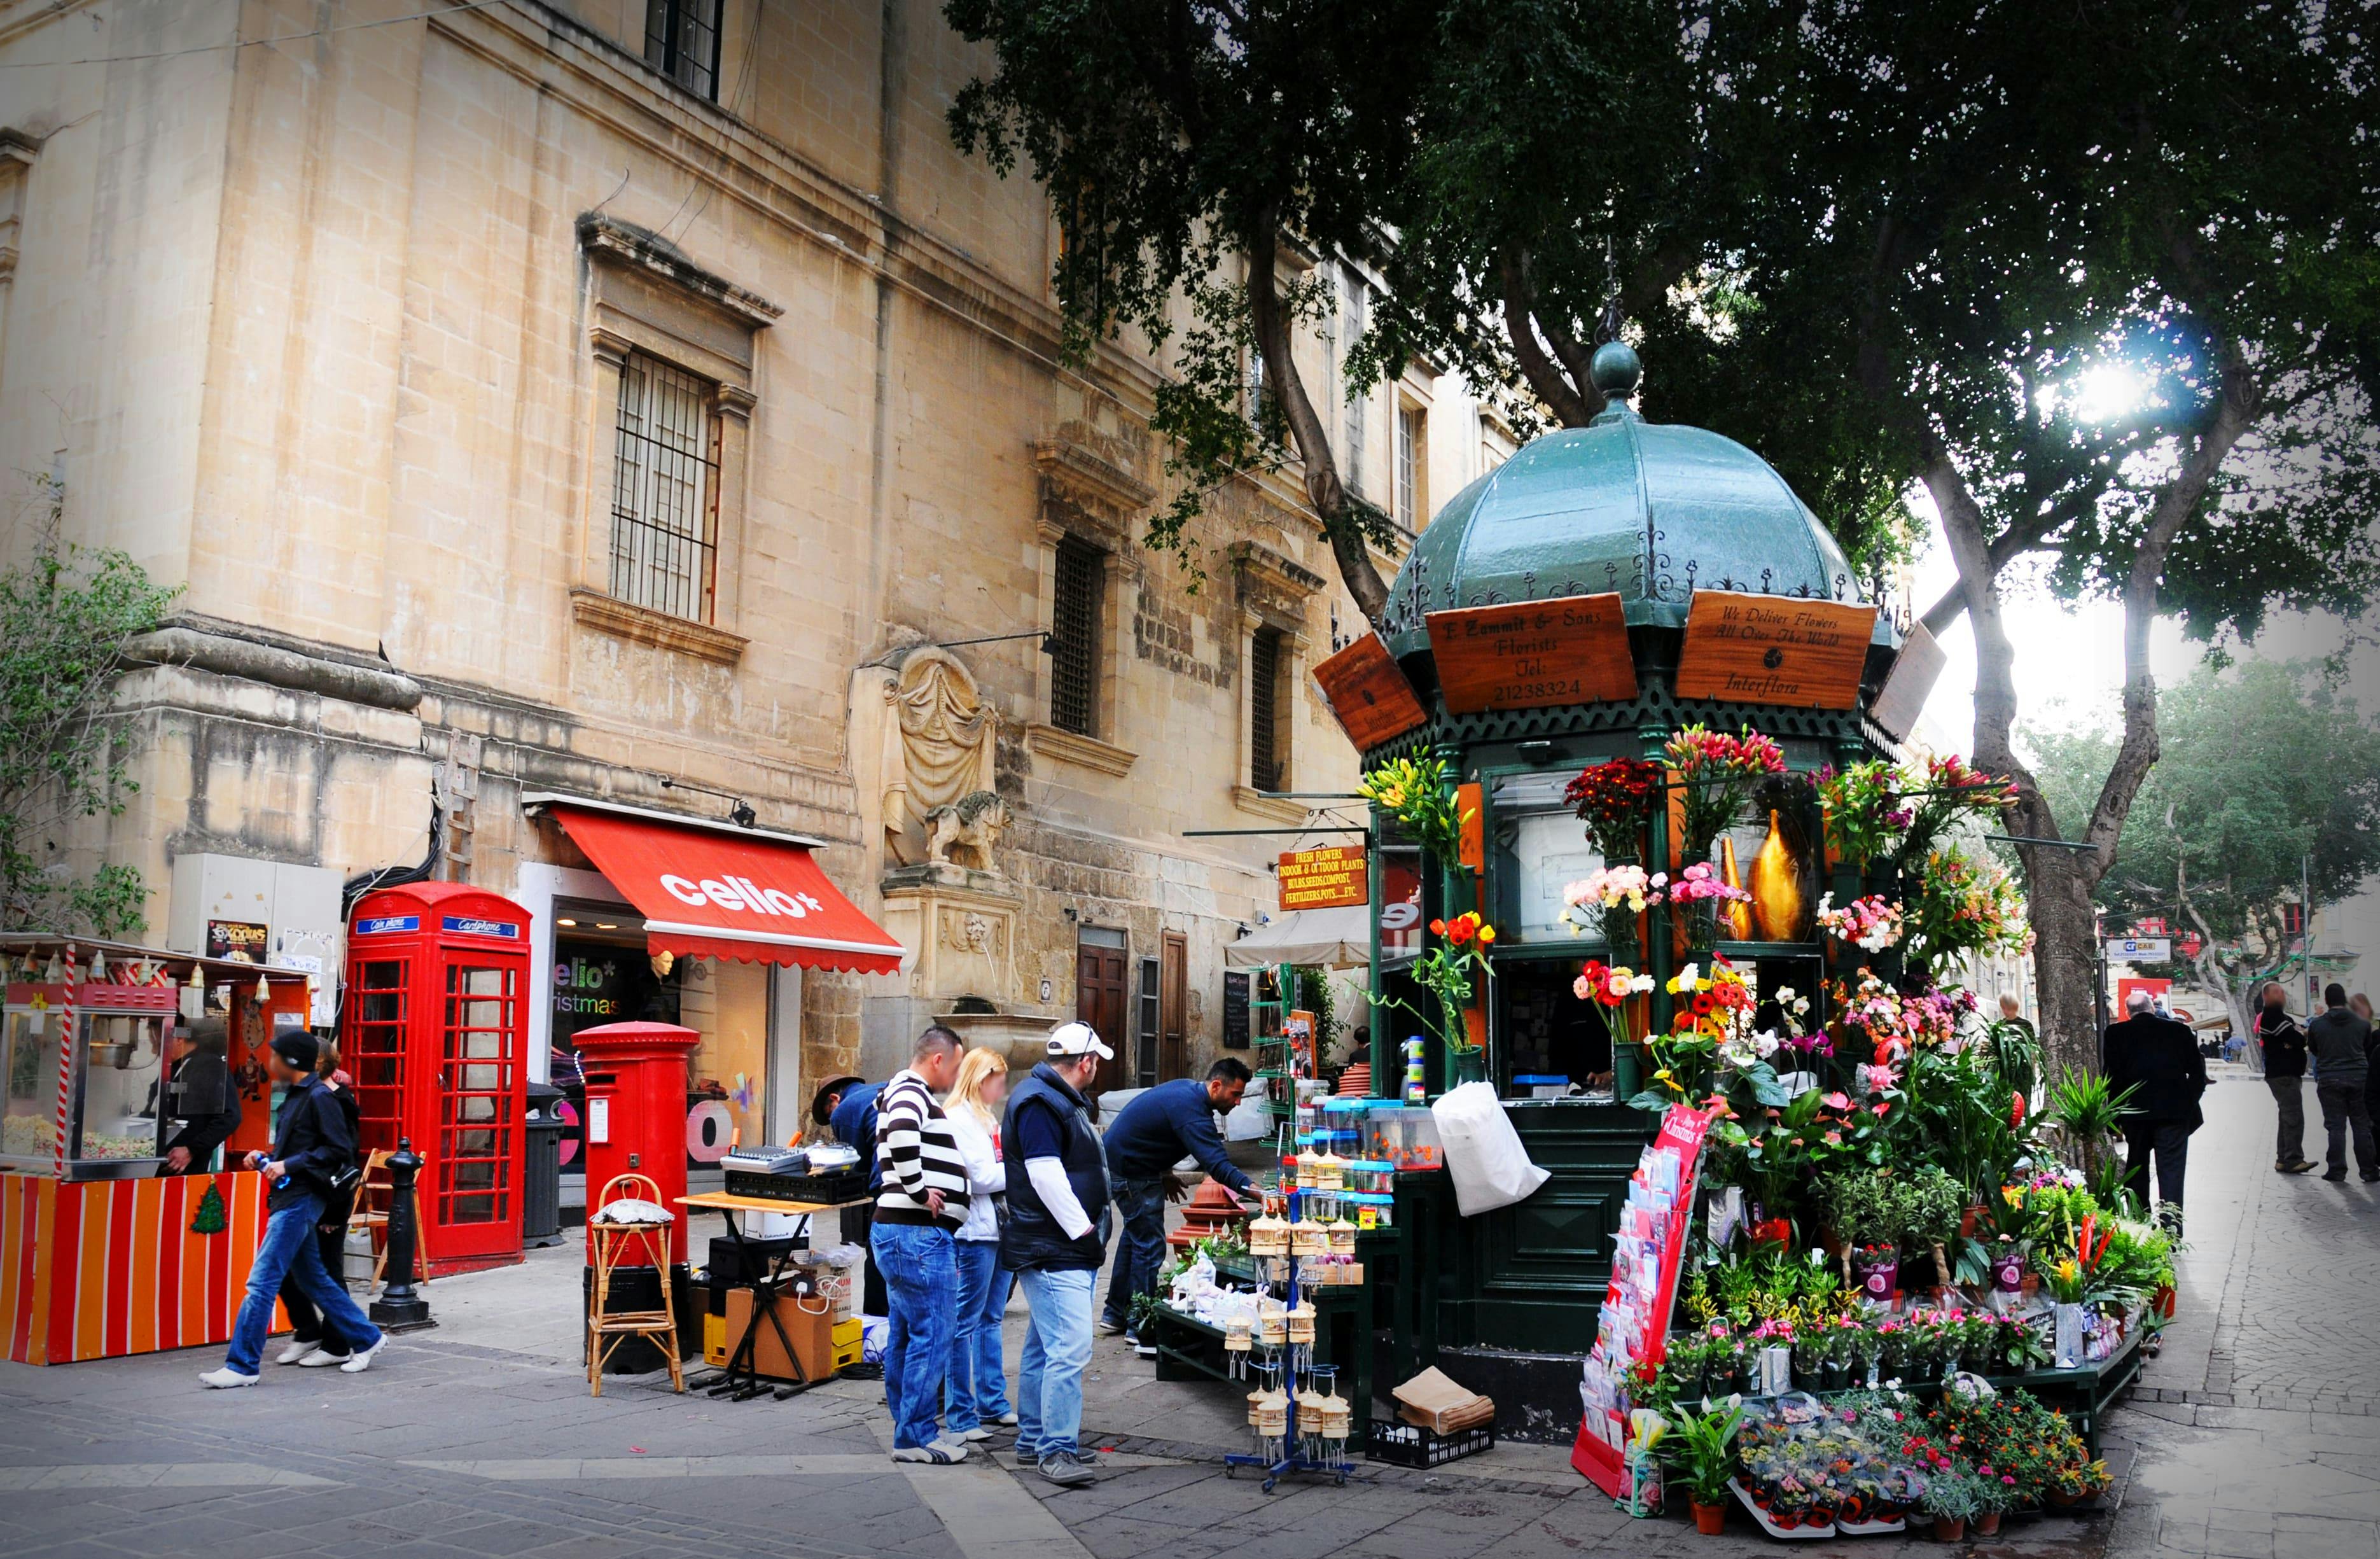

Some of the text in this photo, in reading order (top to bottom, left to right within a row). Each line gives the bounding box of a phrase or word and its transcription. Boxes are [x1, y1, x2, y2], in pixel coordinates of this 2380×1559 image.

[1465, 616, 1526, 637] Zammit
[1534, 614, 1555, 629] &
[1562, 608, 1601, 626] Sons
[1722, 605, 1838, 629] We Deliver Flowers
[1495, 638, 1558, 657] Florists
[1776, 629, 1802, 644] The
[1806, 631, 1841, 647] World
[1515, 658, 1547, 677] Tel:
[1495, 679, 1581, 701] 21238324
[1724, 673, 1800, 698] Interflora
[1295, 848, 1342, 863] FRESH FLOWERS
[1279, 865, 1302, 876] INDOOR
[1341, 858, 1364, 871] PLANTS
[370, 917, 405, 930] Coin phone
[457, 919, 501, 933] Cardphone
